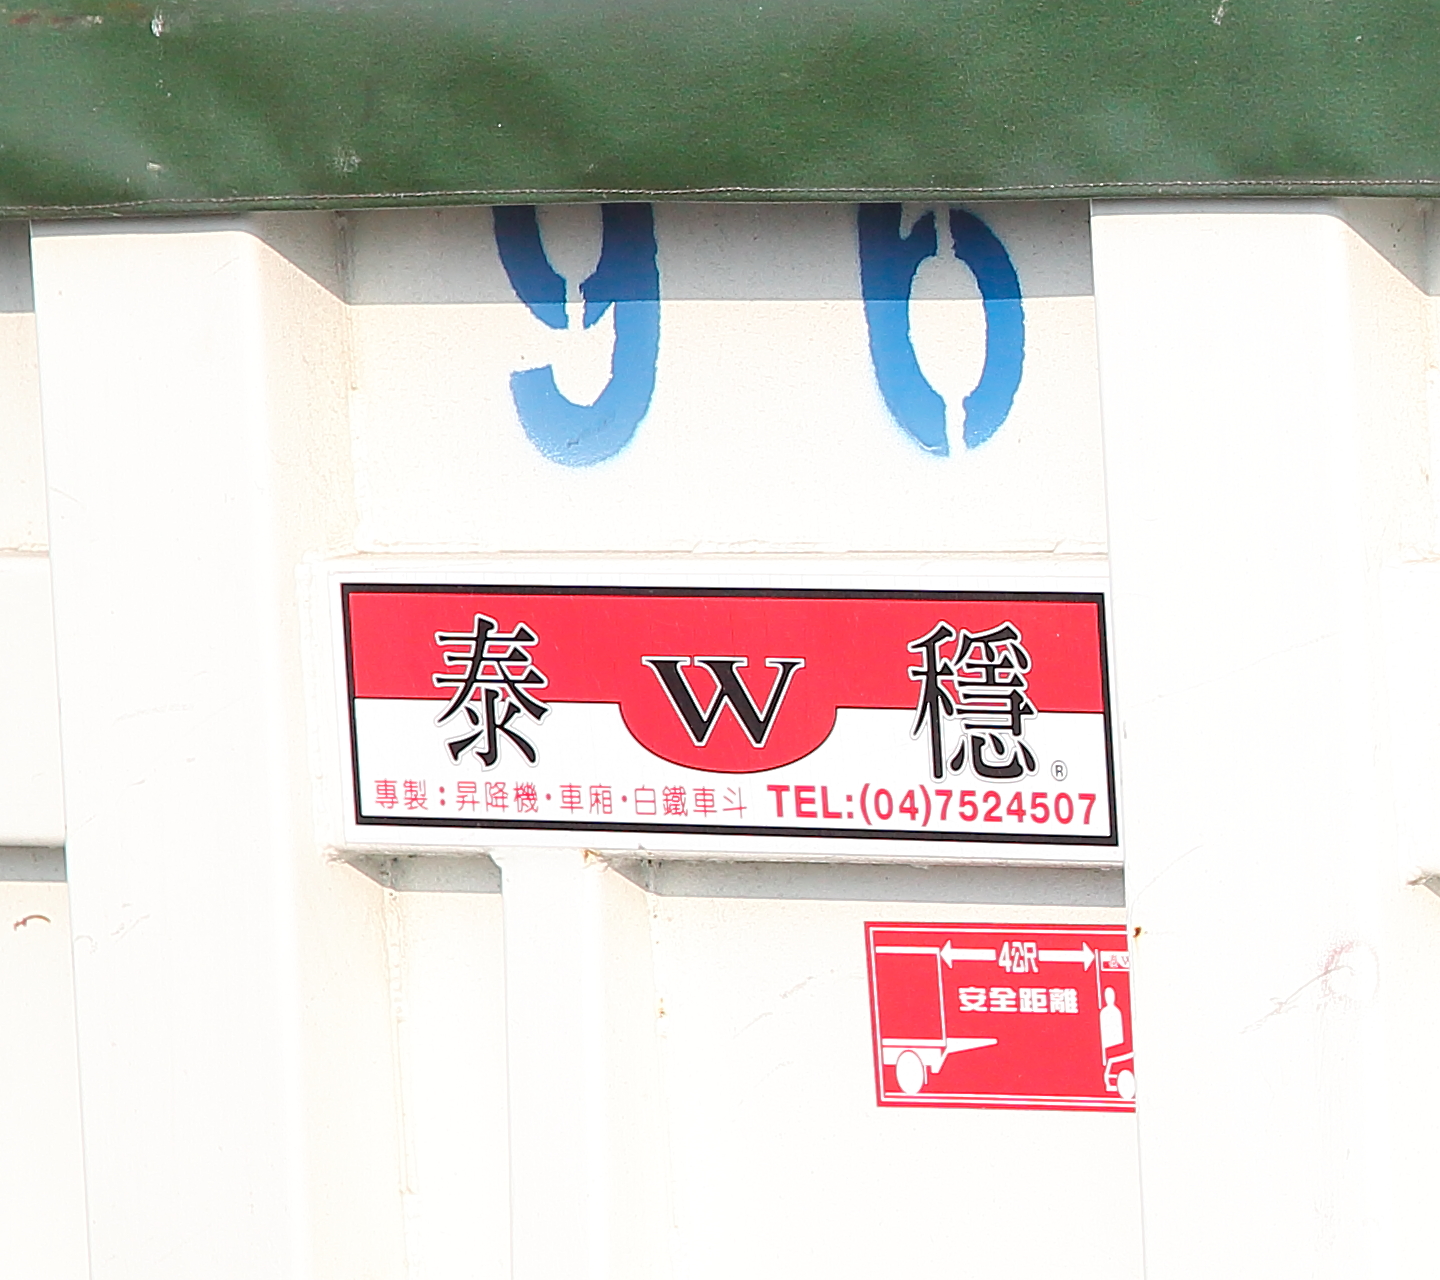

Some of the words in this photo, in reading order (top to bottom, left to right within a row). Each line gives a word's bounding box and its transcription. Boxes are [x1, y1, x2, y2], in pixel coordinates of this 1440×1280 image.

[432, 614, 549, 770] 泰
[641, 655, 806, 747] W
[906, 620, 1039, 782] 穩
[766, 782, 1097, 827] TEL:(04)7524507
[998, 941, 1039, 973] 4公尺
[957, 986, 1079, 1014] 安全距離
